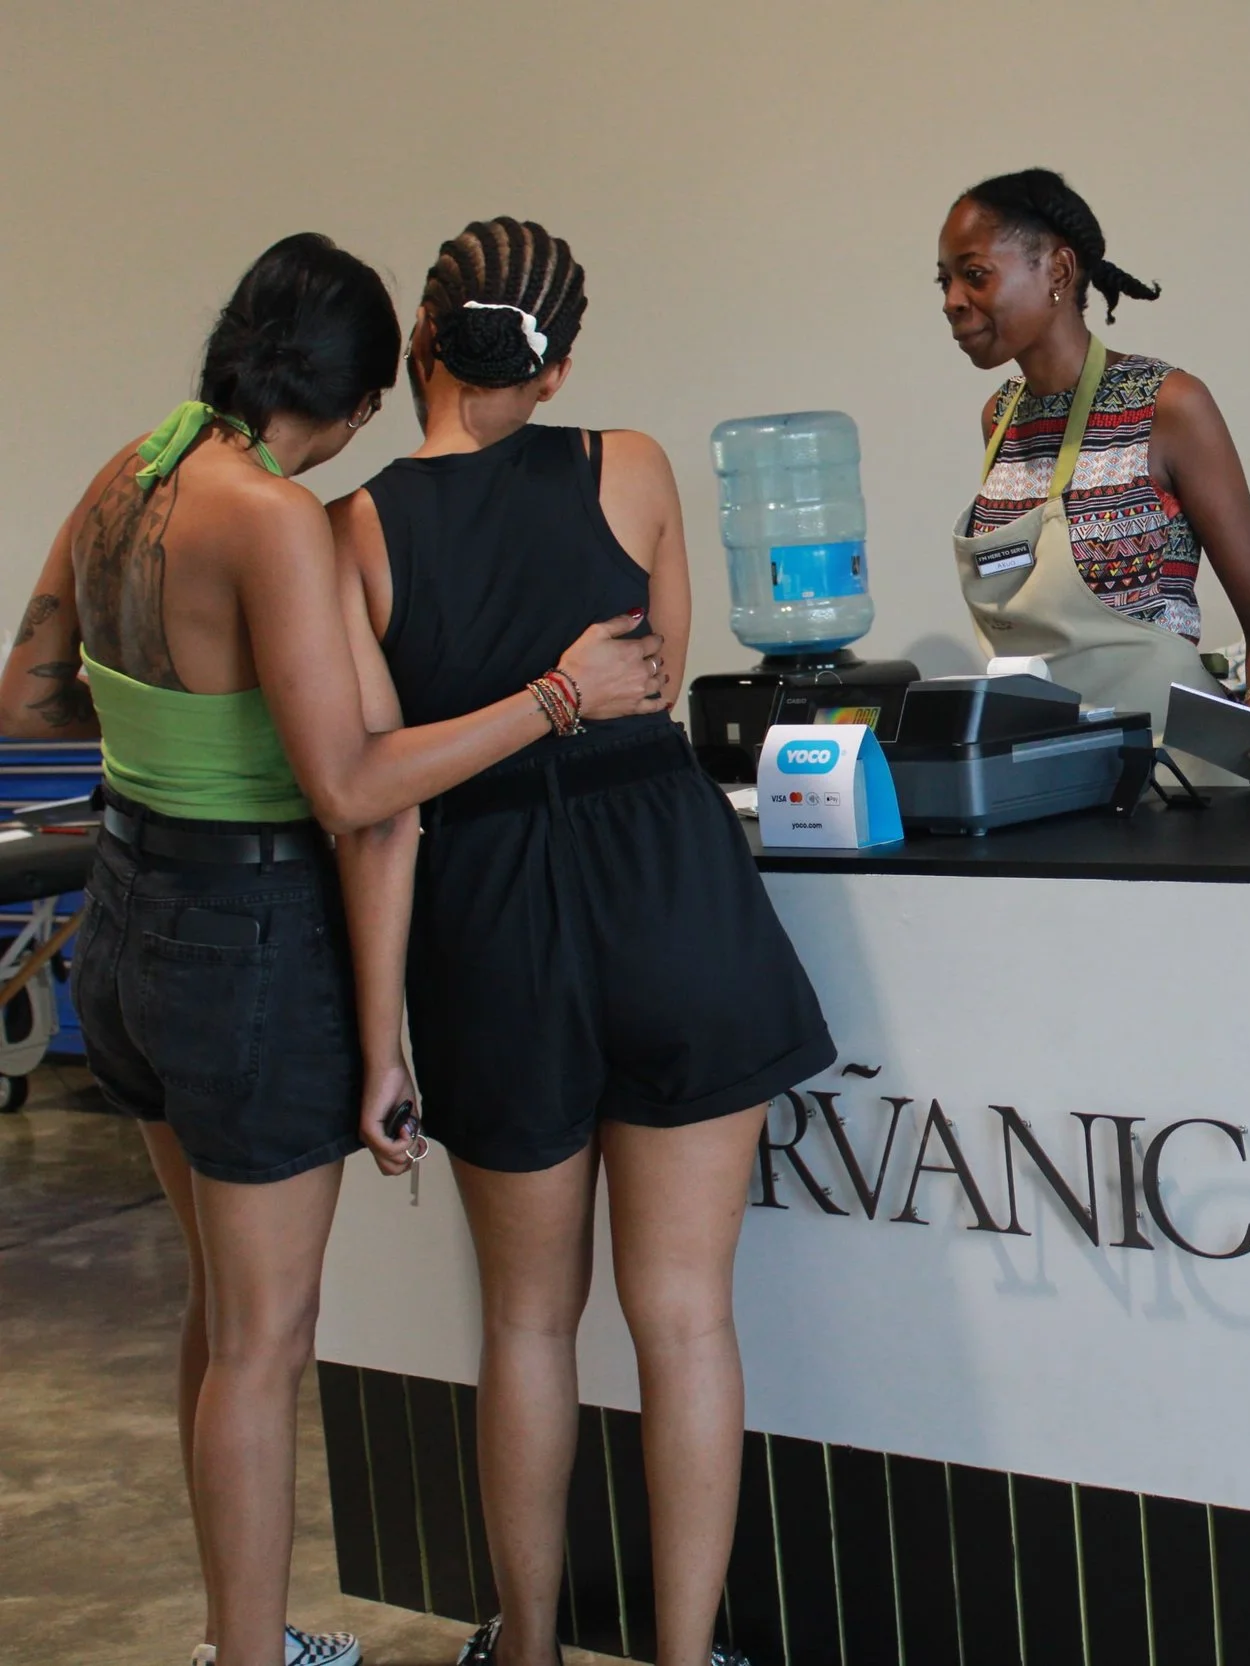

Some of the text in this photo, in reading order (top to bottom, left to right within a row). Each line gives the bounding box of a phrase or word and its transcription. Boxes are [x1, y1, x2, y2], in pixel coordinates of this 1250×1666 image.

[1010, 546, 1027, 554] SERVE
[786, 750, 830, 764] YOCO
[771, 795, 787, 803] VISA
[792, 822, 822, 830] yoco.com
